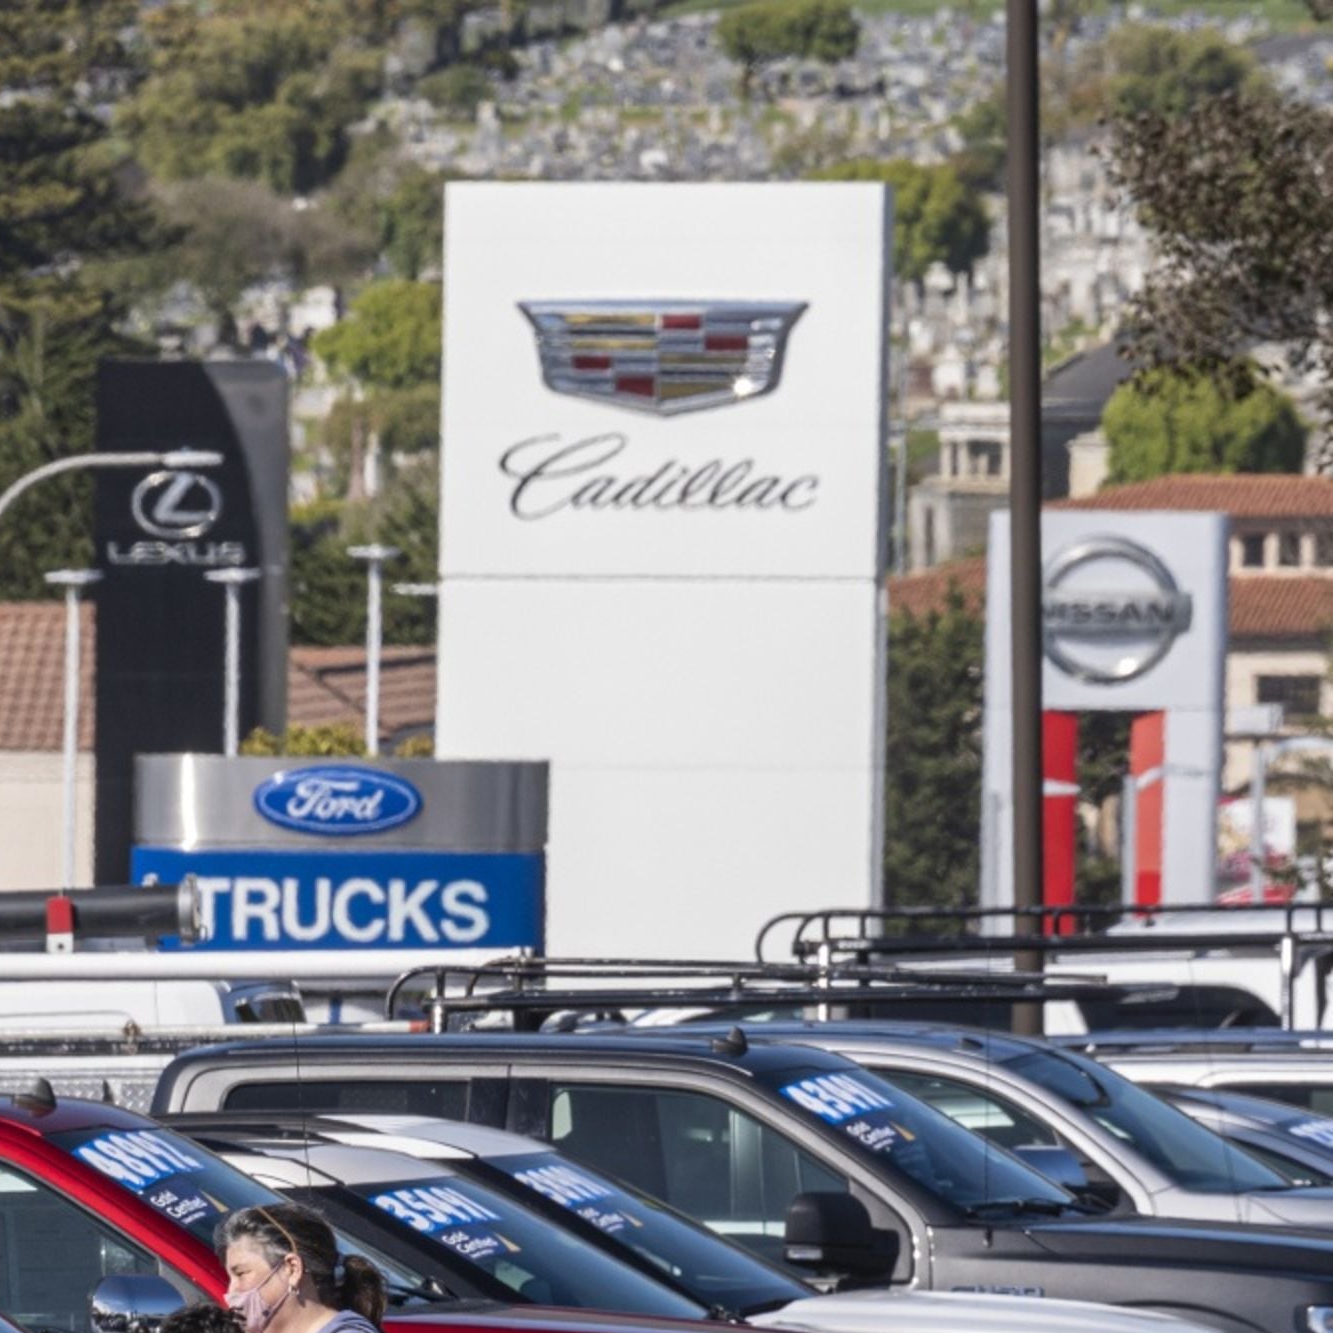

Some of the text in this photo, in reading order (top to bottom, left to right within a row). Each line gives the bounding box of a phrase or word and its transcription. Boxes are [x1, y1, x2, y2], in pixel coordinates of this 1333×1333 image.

[498, 431, 820, 522] Cadillac
[106, 541, 245, 565] LEXUS
[286, 778, 385, 820] Ford
[197, 877, 489, 943] TRUCKS
[78, 1131, 203, 1186] 48992
